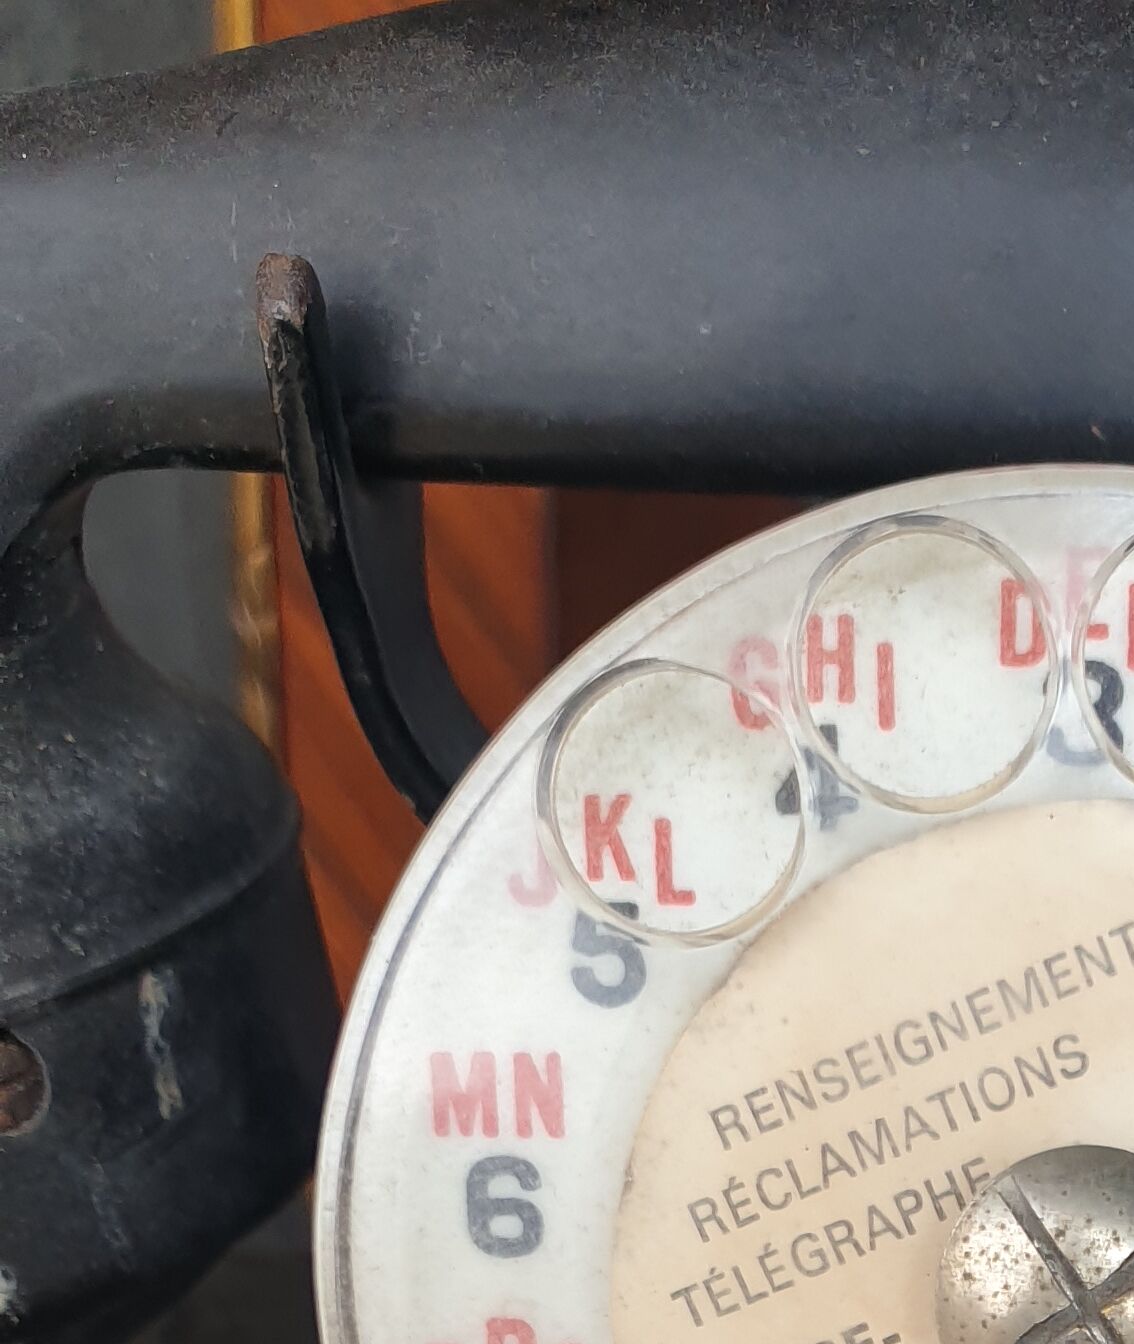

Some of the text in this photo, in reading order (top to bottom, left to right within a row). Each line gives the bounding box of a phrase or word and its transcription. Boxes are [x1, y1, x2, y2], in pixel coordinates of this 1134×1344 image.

[729, 613, 895, 731] GHI
[1042, 657, 1125, 767] 3
[775, 723, 860, 832] 4
[508, 793, 697, 908] JKL
[571, 902, 647, 1009] 5
[429, 1051, 566, 1139] MN
[687, 1033, 1090, 1243] RÉCLAMATIONS
[465, 1155, 544, 1259] 6
